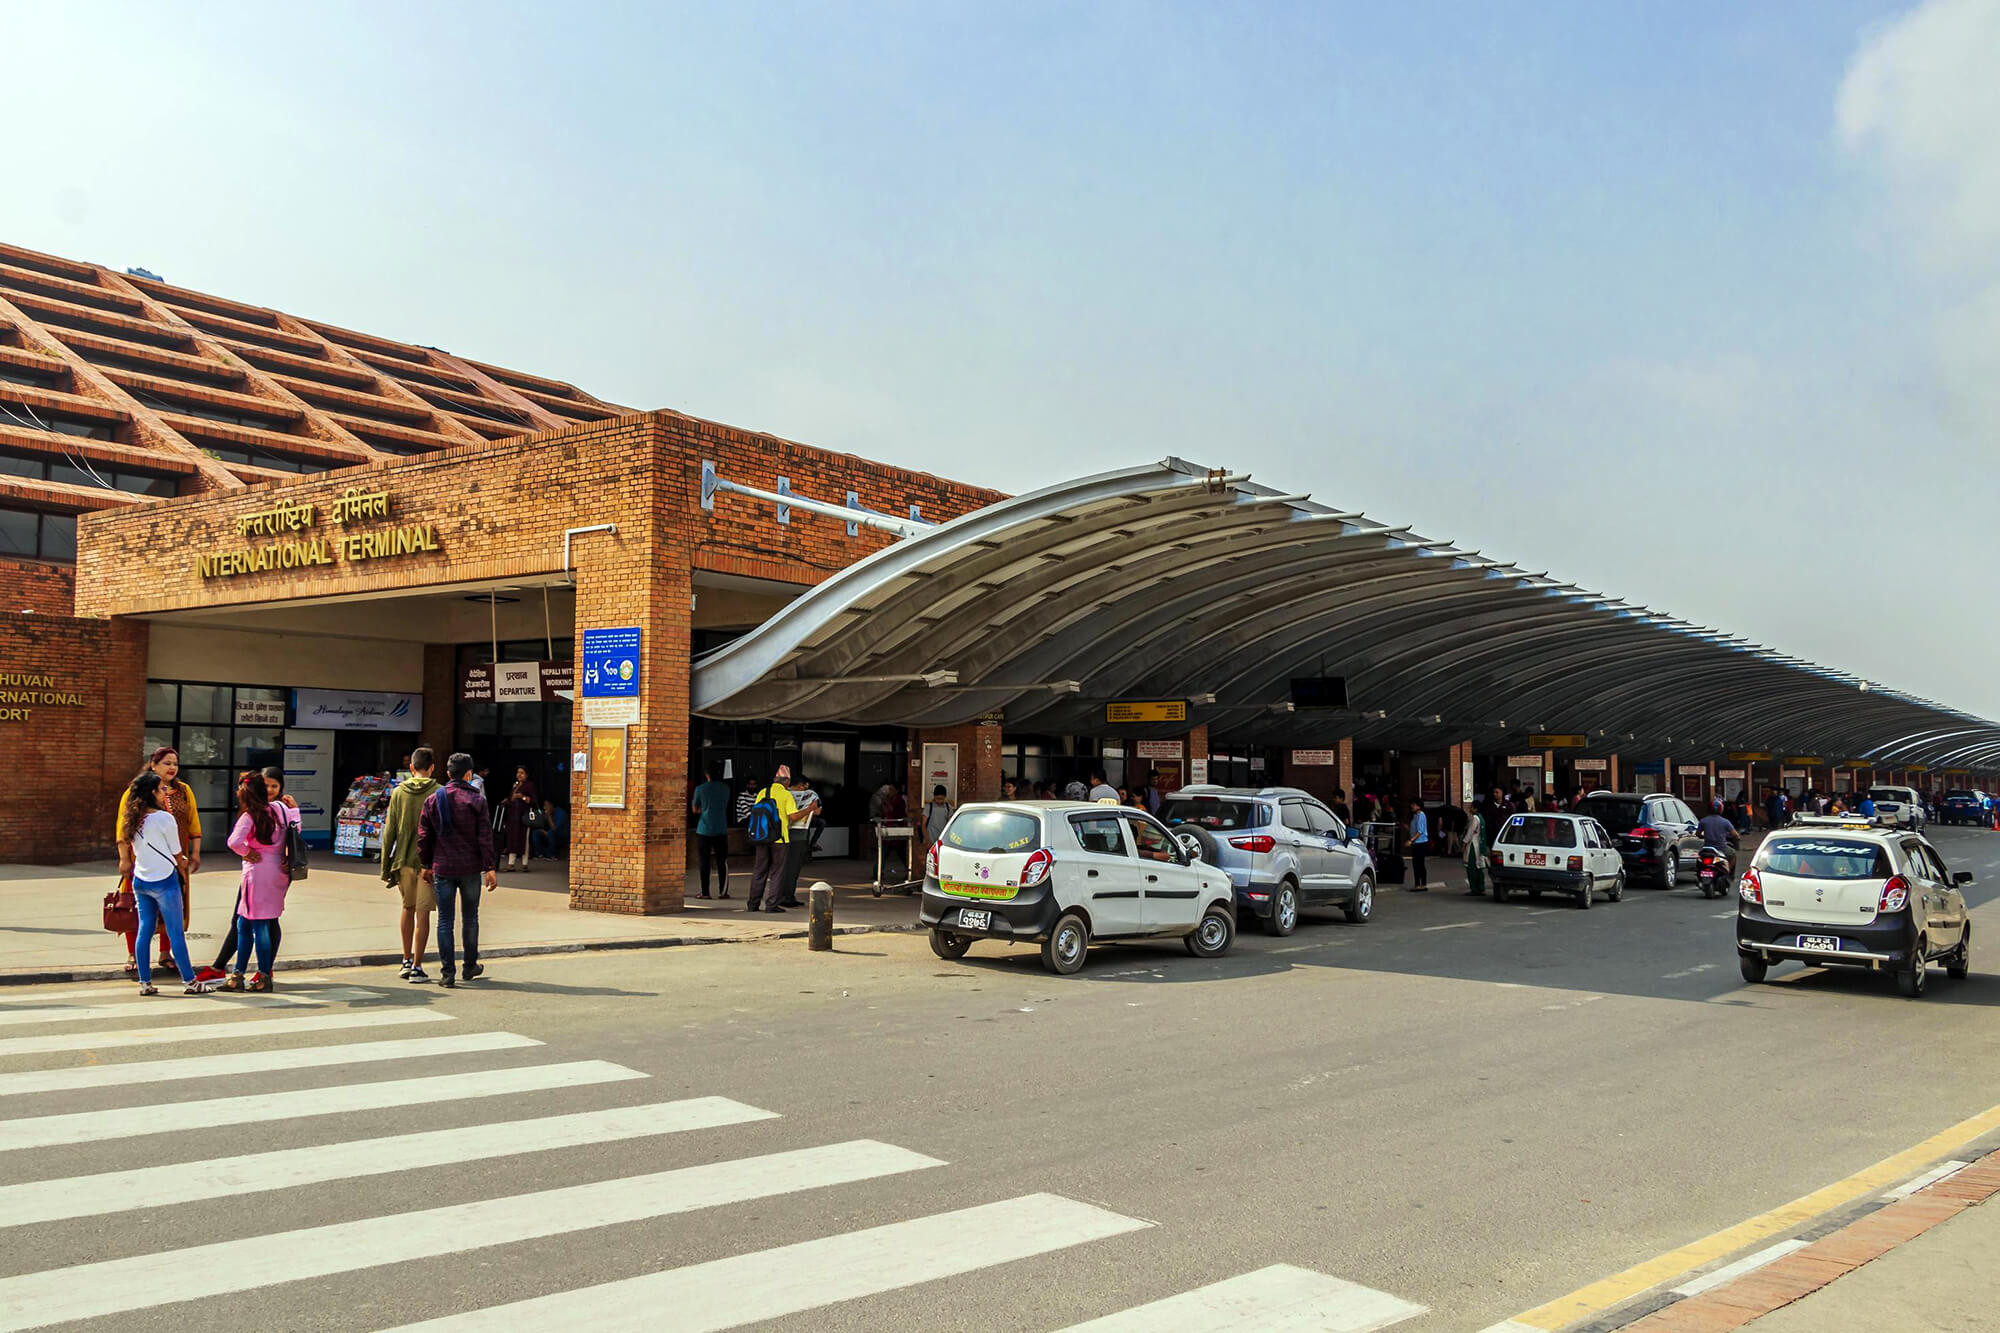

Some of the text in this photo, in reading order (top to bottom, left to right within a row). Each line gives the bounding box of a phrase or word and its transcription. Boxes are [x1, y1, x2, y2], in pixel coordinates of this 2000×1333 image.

[196, 524, 440, 579] INTERNATIONAL TERMINAL
[541, 668, 561, 676] NEPALI
[0, 674, 55, 688] HUVAN
[546, 679, 573, 687] WORKING
[499, 687, 536, 696] DEPARTURE
[1008, 837, 1029, 849] TAXI
